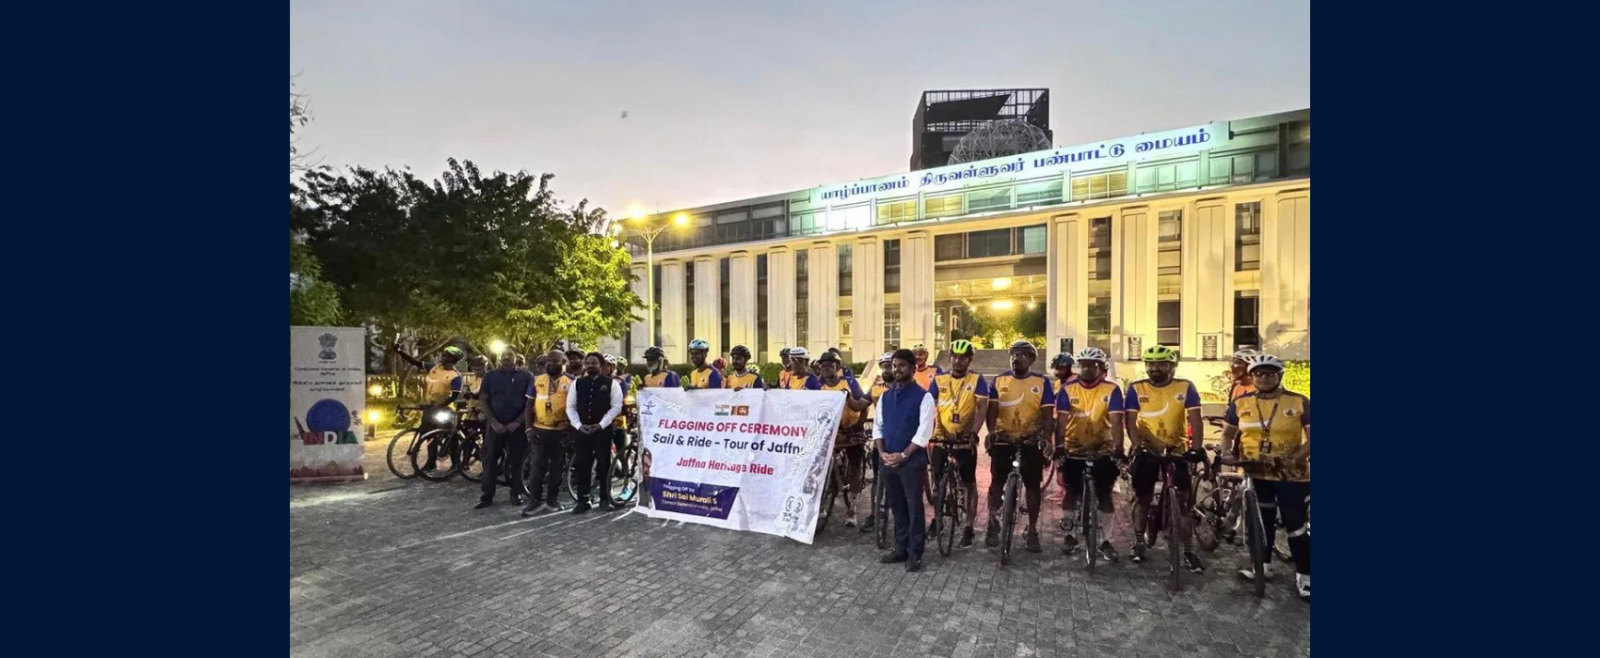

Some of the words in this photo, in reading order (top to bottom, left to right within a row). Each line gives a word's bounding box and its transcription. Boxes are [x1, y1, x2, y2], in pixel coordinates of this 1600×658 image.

[821, 176, 909, 201] யாழ்ப்பாணம்
[919, 158, 1025, 188] திருவள்ளுவர்
[1033, 143, 1126, 168] பண்பாட்டு
[1134, 128, 1211, 153] மையம்
[658, 419, 714, 432] FLAGGING
[716, 422, 737, 433] OFF
[739, 423, 808, 438] CEREMONY
[652, 433, 674, 445] Sail
[676, 435, 685, 446] &
[687, 435, 712, 448] Ride
[723, 438, 749, 450] Tour
[751, 441, 765, 451] of
[677, 457, 706, 468] Jaffna
[749, 463, 774, 475] Ride
[662, 491, 677, 499] Shri
[678, 492, 688, 500] Sai
[689, 494, 711, 504] Murali
